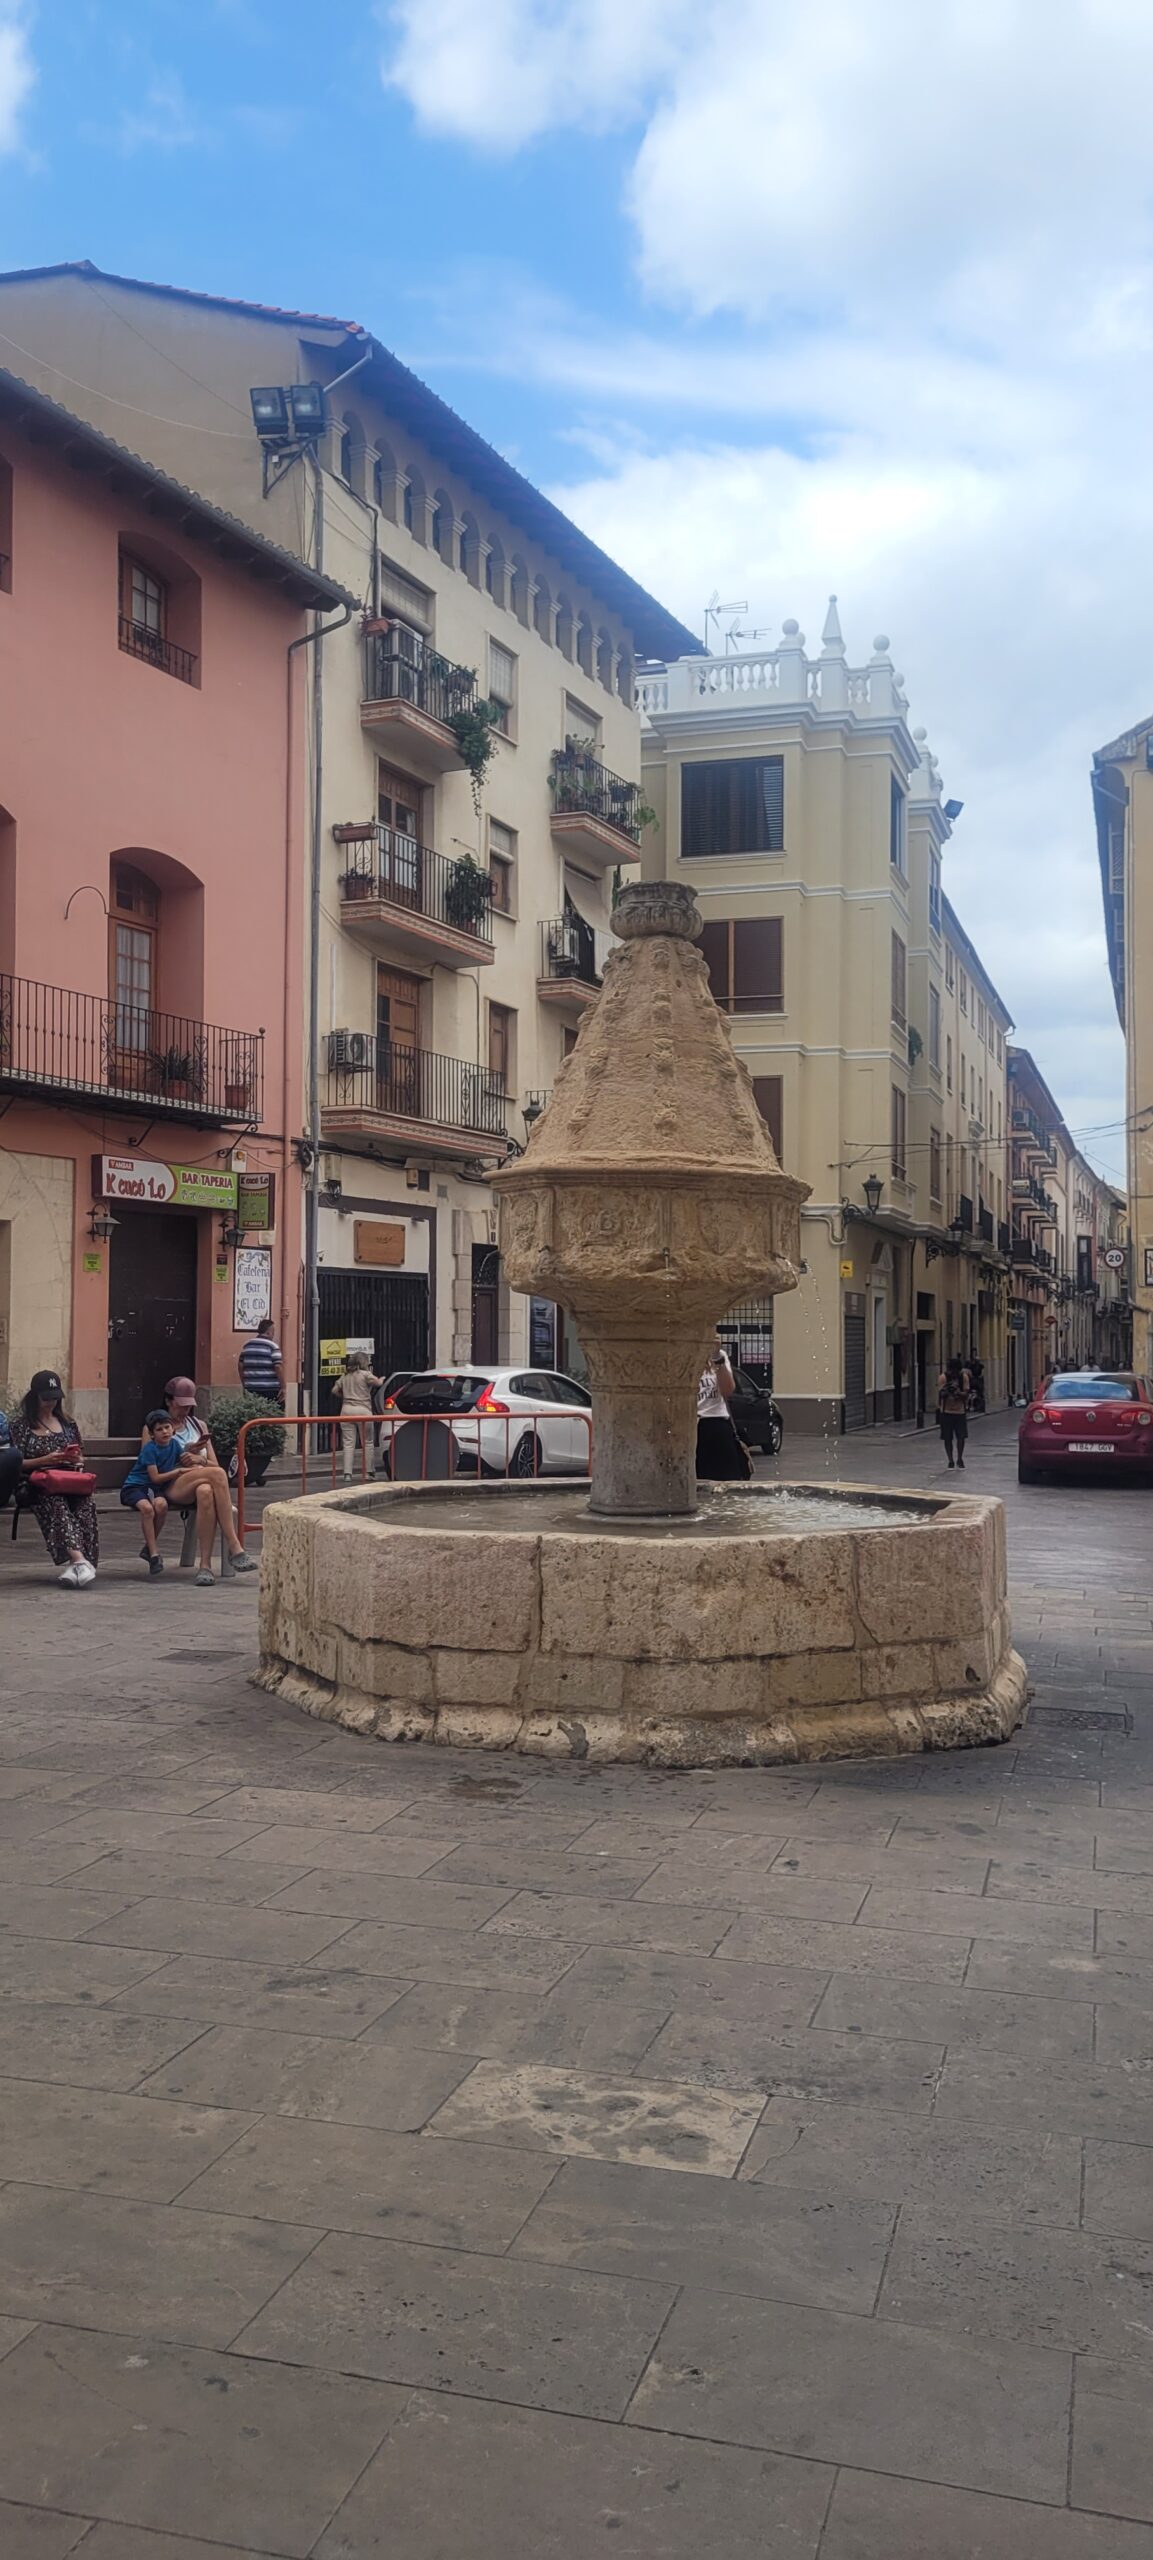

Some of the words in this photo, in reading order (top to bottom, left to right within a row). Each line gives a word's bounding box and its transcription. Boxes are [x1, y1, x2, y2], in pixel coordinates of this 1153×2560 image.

[106, 1172, 116, 1194] K
[181, 1172, 199, 1185] BAR
[1108, 1254, 1122, 1263] 20
[244, 1281, 261, 1293] Bar
[240, 1298, 250, 1310] El
[252, 1298, 266, 1310] Cid
